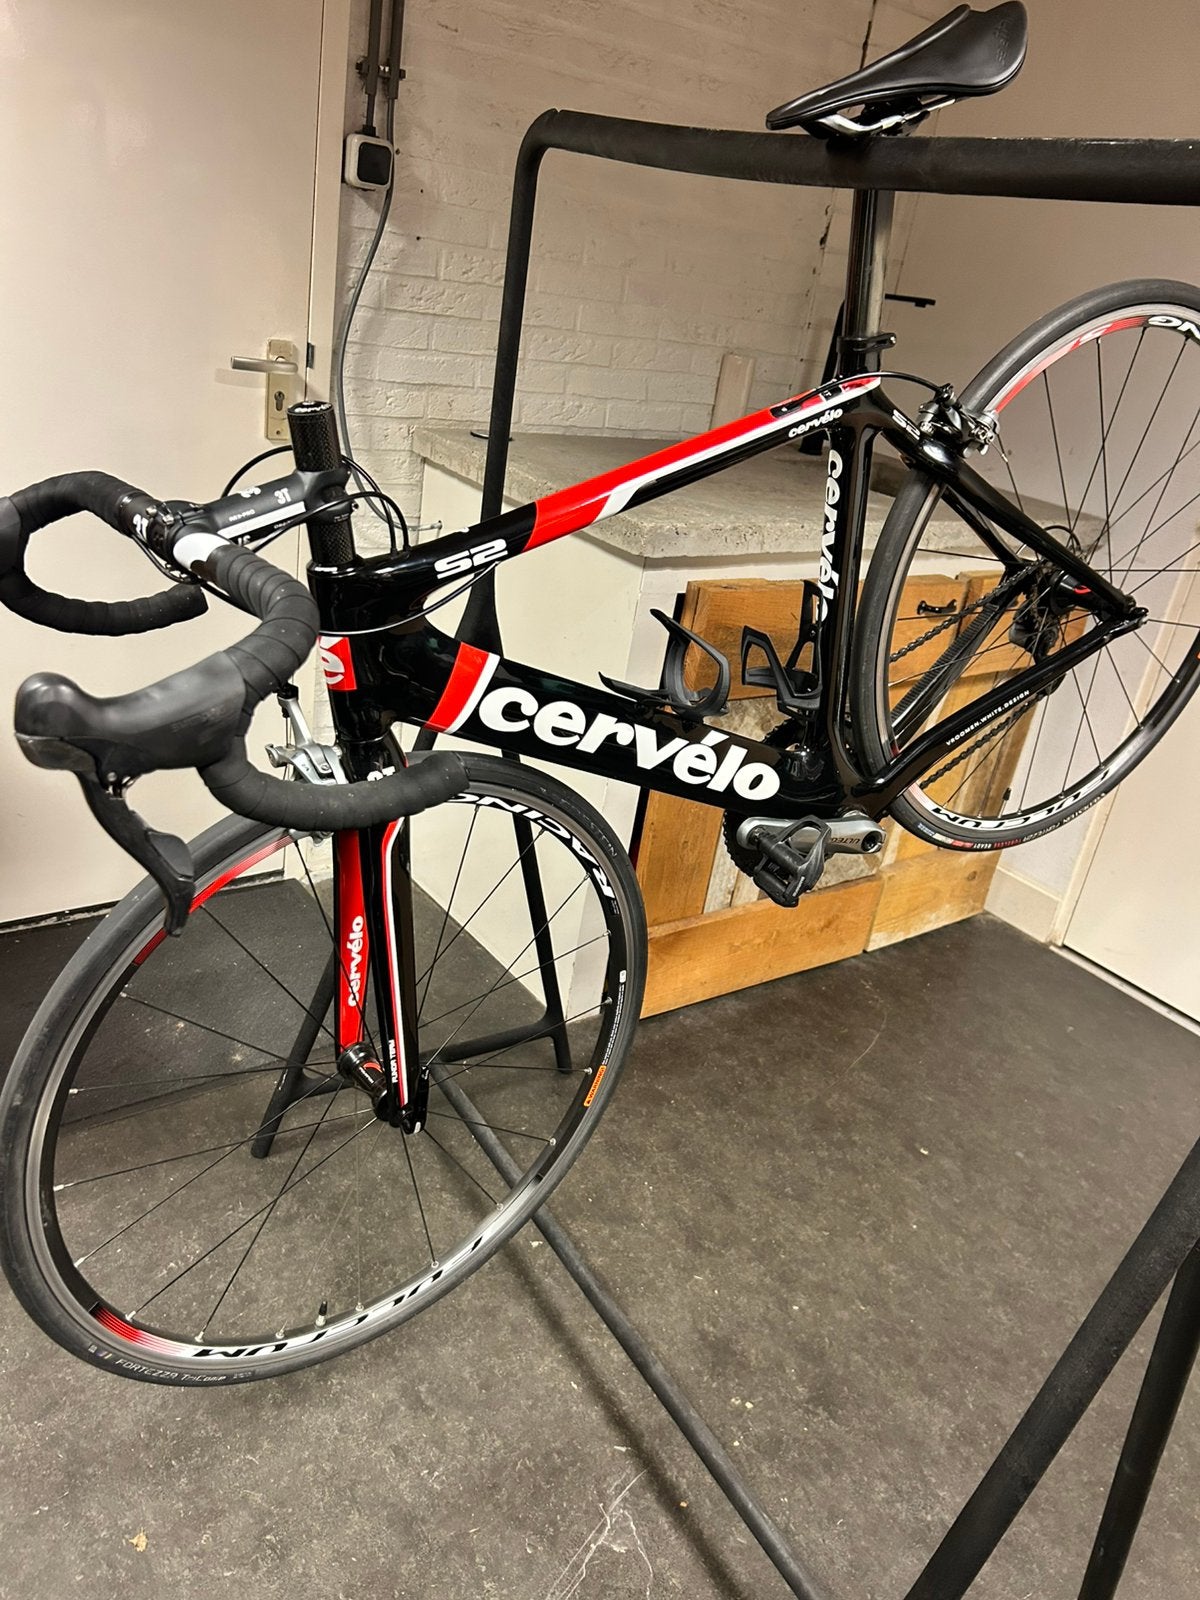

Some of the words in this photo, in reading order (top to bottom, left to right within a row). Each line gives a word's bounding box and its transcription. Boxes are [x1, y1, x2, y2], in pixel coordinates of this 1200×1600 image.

[788, 408, 843, 438] cervélo
[274, 488, 291, 504] 3T
[815, 449, 843, 622] cervélo
[434, 538, 508, 580] S2
[478, 687, 781, 801] cervélo
[831, 837, 861, 845] ULTEG
[973, 842, 992, 850] READY
[347, 915, 364, 1006] cervélo
